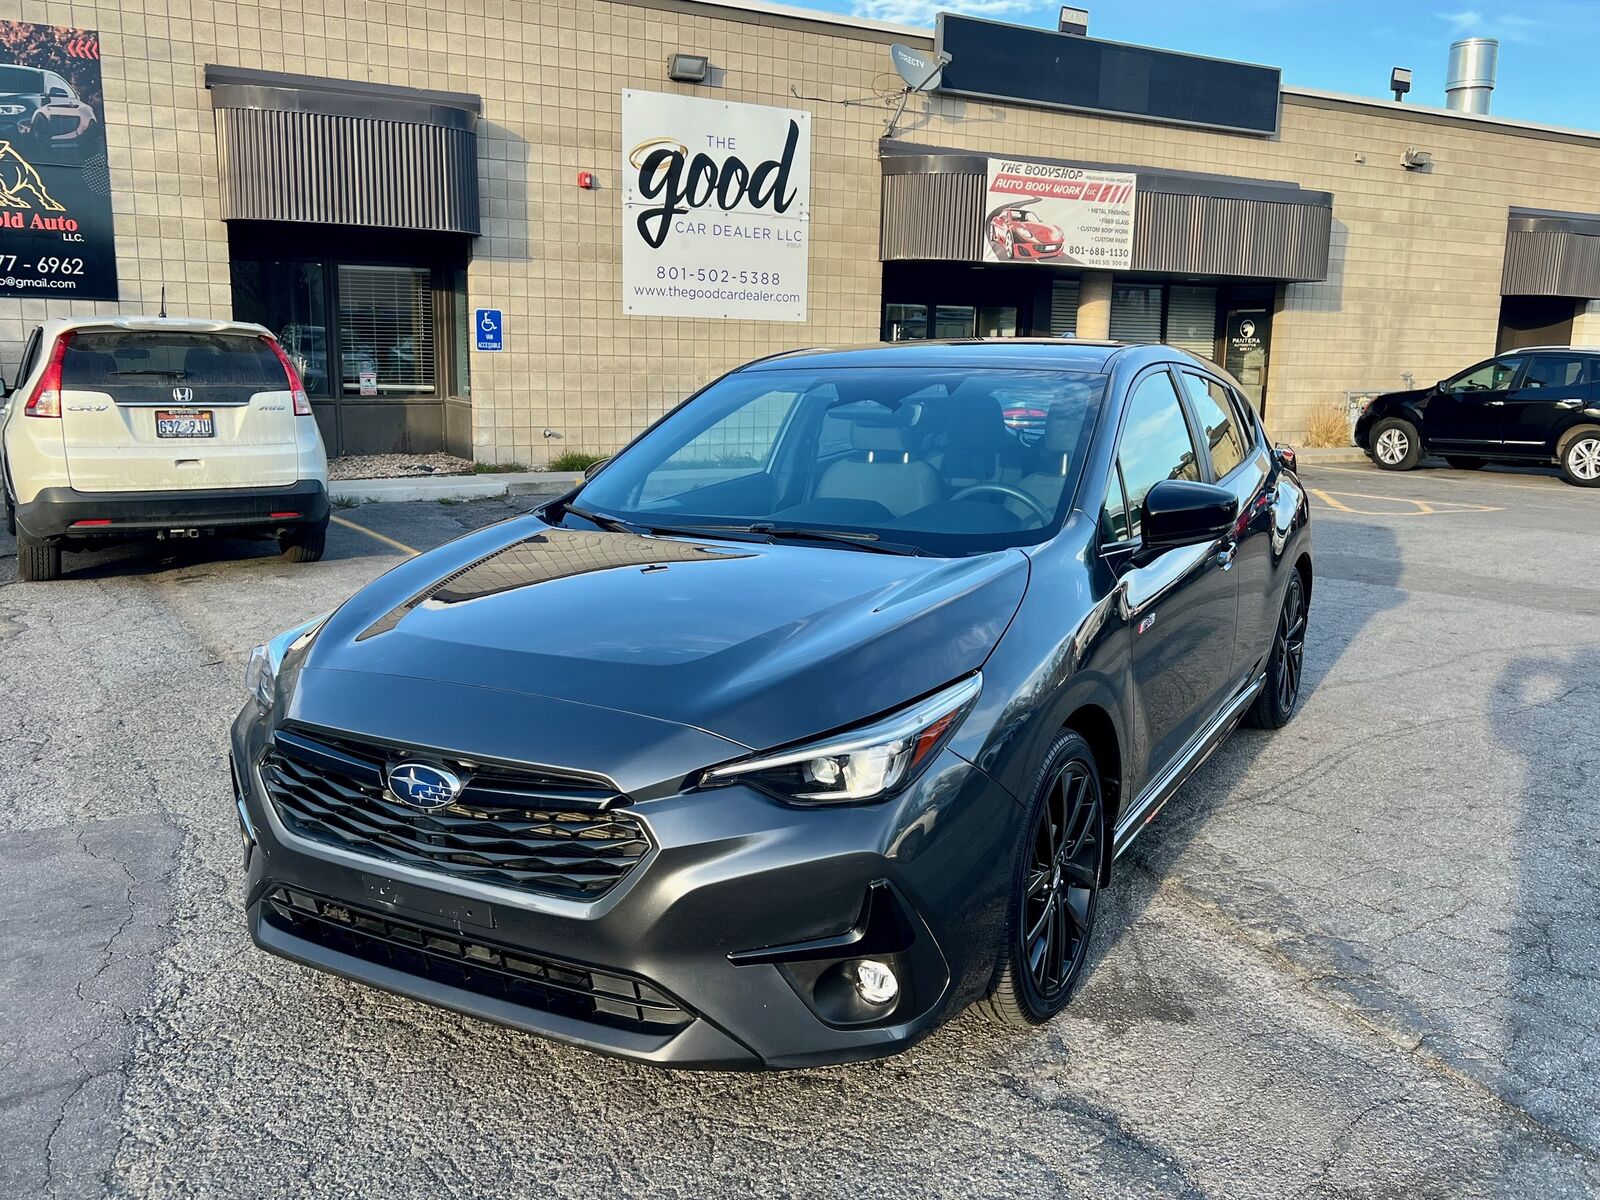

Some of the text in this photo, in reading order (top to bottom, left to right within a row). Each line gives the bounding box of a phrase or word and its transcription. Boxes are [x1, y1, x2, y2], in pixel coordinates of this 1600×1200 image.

[899, 51, 925, 68] DIRECTV
[706, 134, 736, 150] THE
[1000, 162, 1084, 180] THE BODYSHOP
[637, 118, 800, 249] good
[995, 178, 1023, 190] AUTO
[1025, 181, 1052, 193] BODY
[1053, 184, 1082, 196] WORK
[30, 213, 78, 232] Auto
[675, 221, 802, 242] CAR DEALER LLC
[63, 233, 85, 242] LLC.
[1069, 245, 1129, 258] 801-688-1130
[37, 257, 84, 275] 6962
[656, 266, 781, 286] 801-502-5388
[634, 285, 801, 303] www.thegoodcardealer.com
